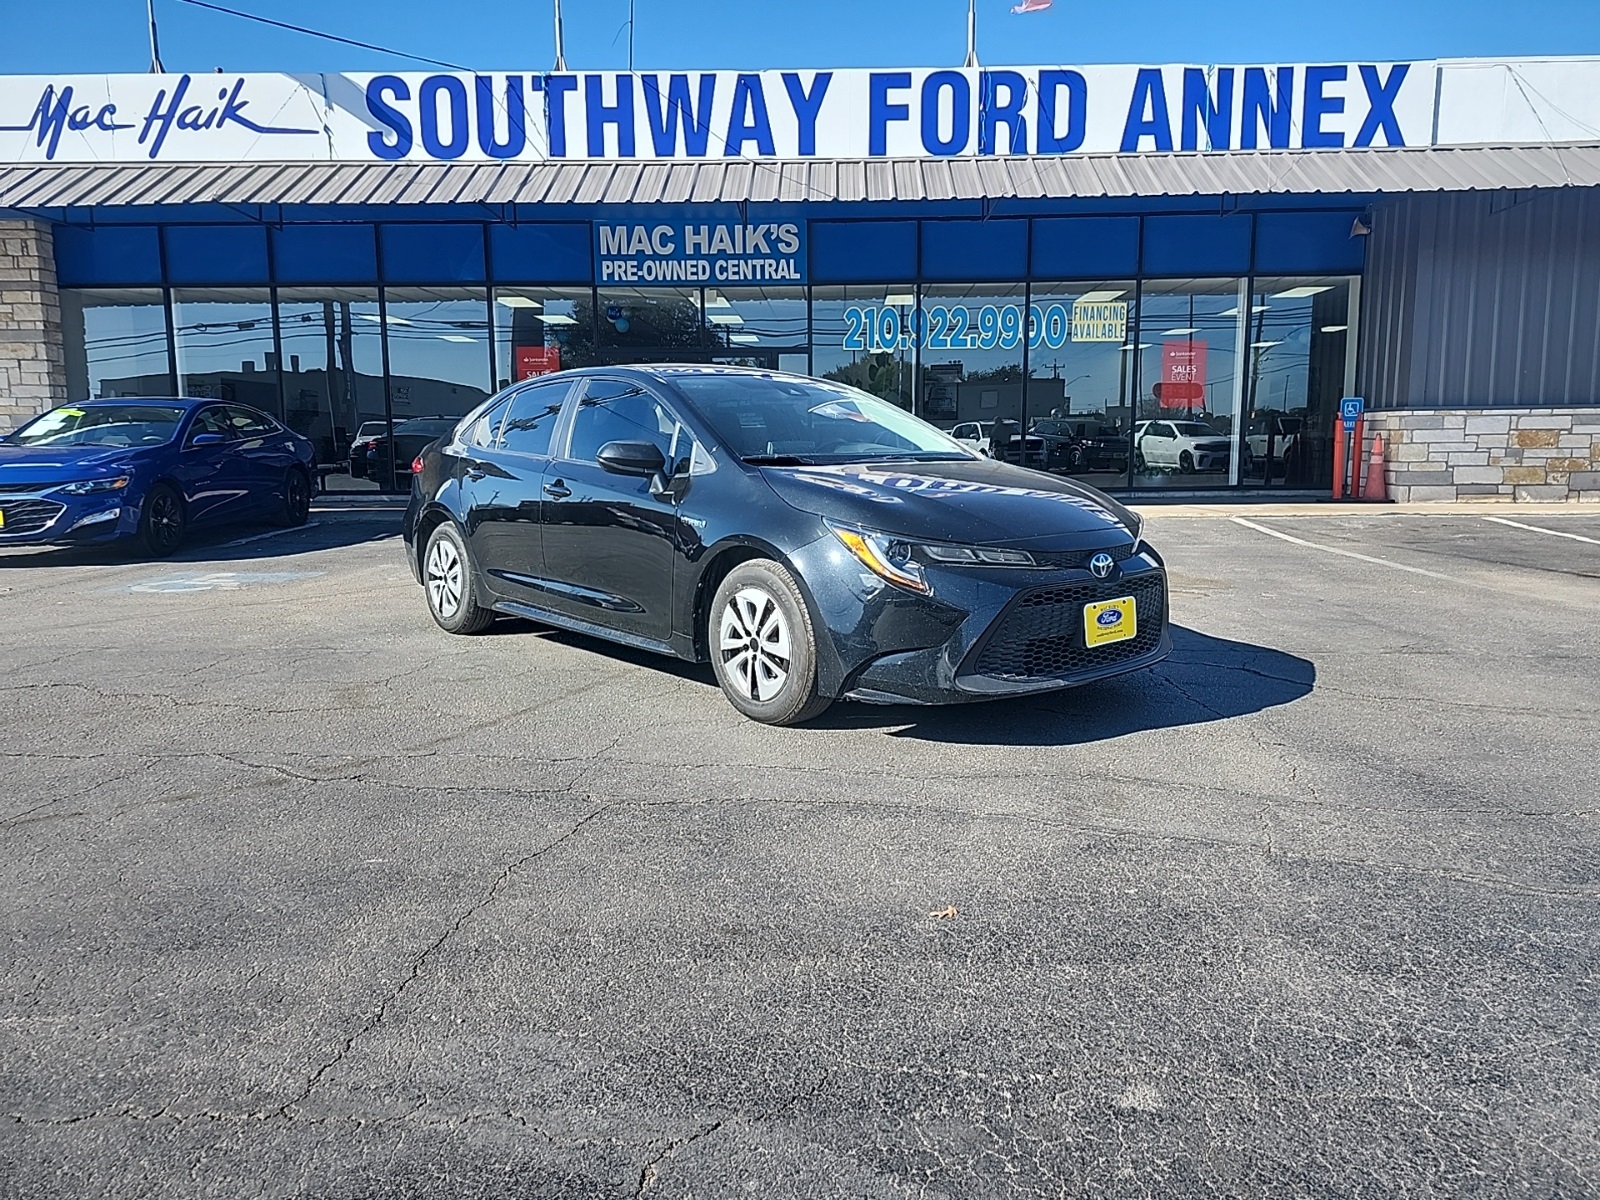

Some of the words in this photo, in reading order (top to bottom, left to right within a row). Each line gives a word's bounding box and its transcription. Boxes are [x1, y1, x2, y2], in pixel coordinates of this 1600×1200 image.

[0, 84, 136, 160] Mac
[138, 74, 319, 159] Haik
[366, 71, 832, 160] SOUTHWAY
[869, 70, 1088, 156] FORD
[1120, 64, 1411, 153] ANNEX
[599, 225, 675, 255] MAC
[684, 224, 800, 254] HAIK'S
[602, 260, 710, 281] PRE-OWNED
[715, 259, 801, 280] CENTRAL
[1074, 305, 1126, 321] FINANCING
[843, 305, 1068, 350] 210.922.9900
[1072, 323, 1125, 339] AVAILABLE
[1171, 365, 1197, 373] SALES
[1171, 373, 1196, 381] EVENT
